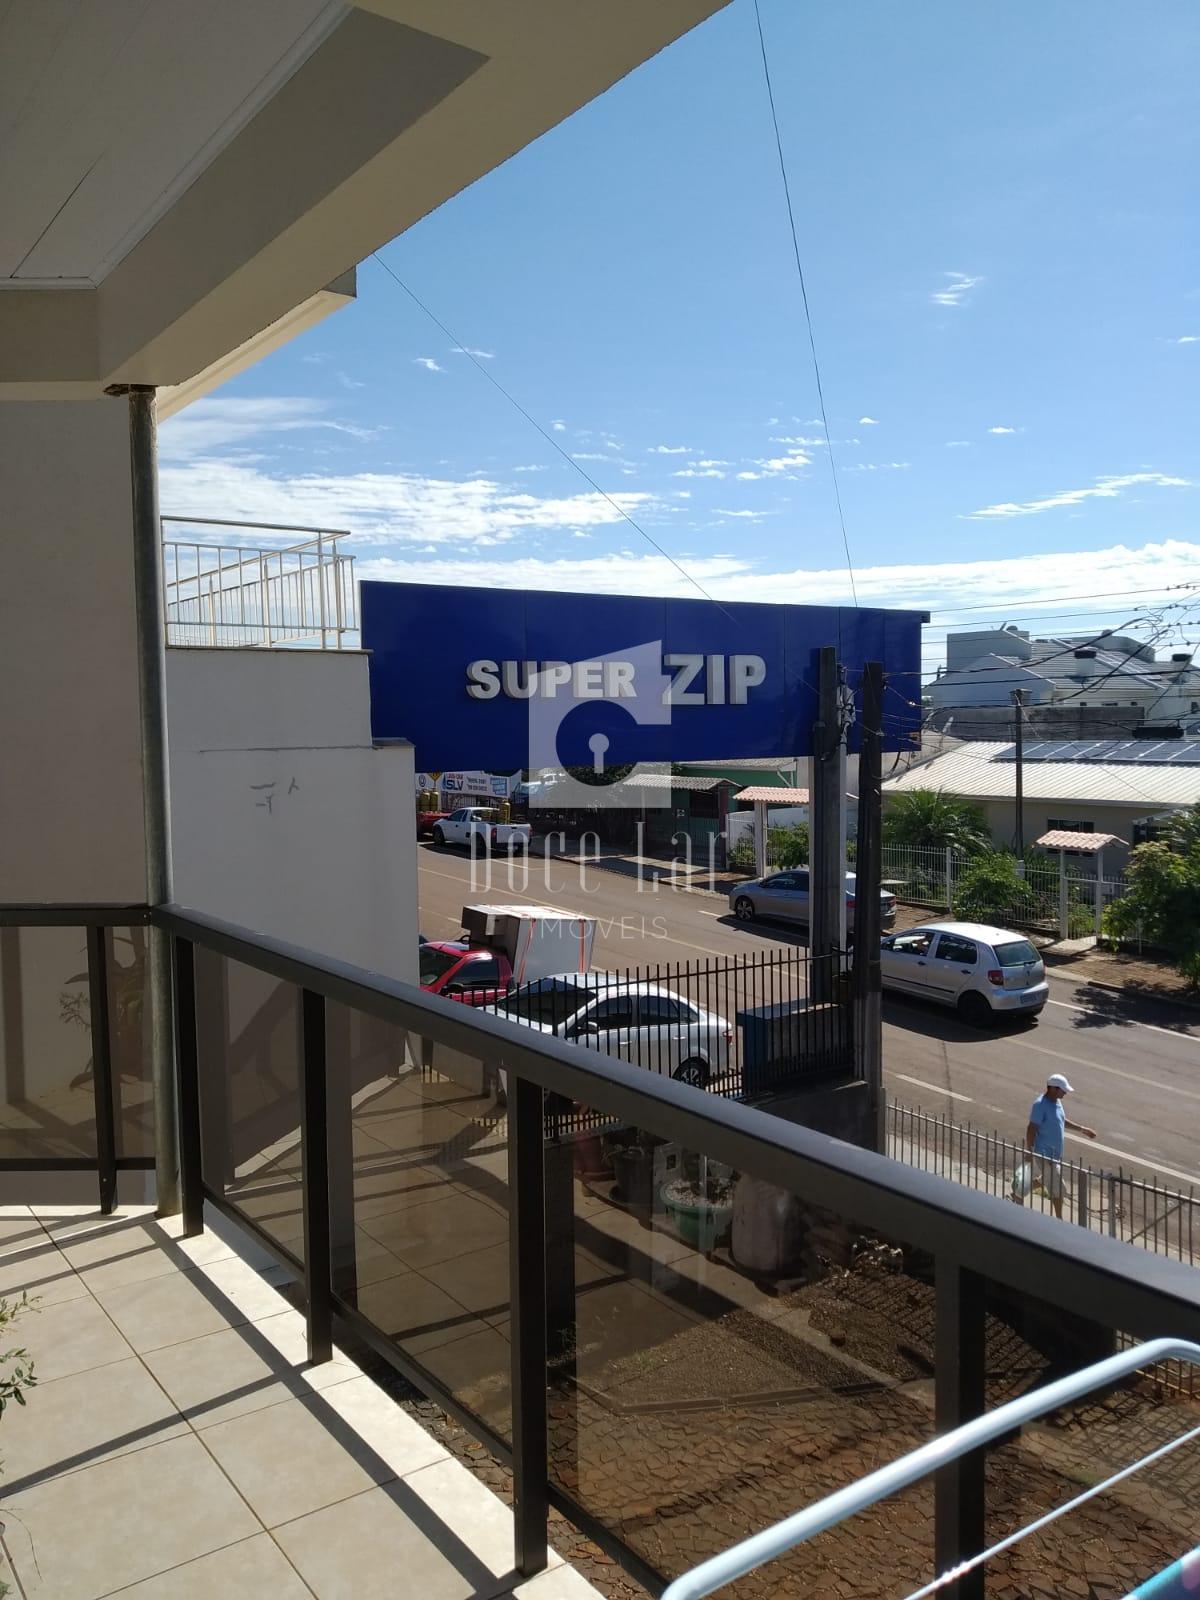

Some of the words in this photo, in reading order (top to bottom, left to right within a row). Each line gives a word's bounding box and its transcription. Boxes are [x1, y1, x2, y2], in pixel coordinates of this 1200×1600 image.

[466, 659, 637, 699] SUPER
[662, 654, 767, 705] ZIP
[445, 779, 464, 792] SLV
